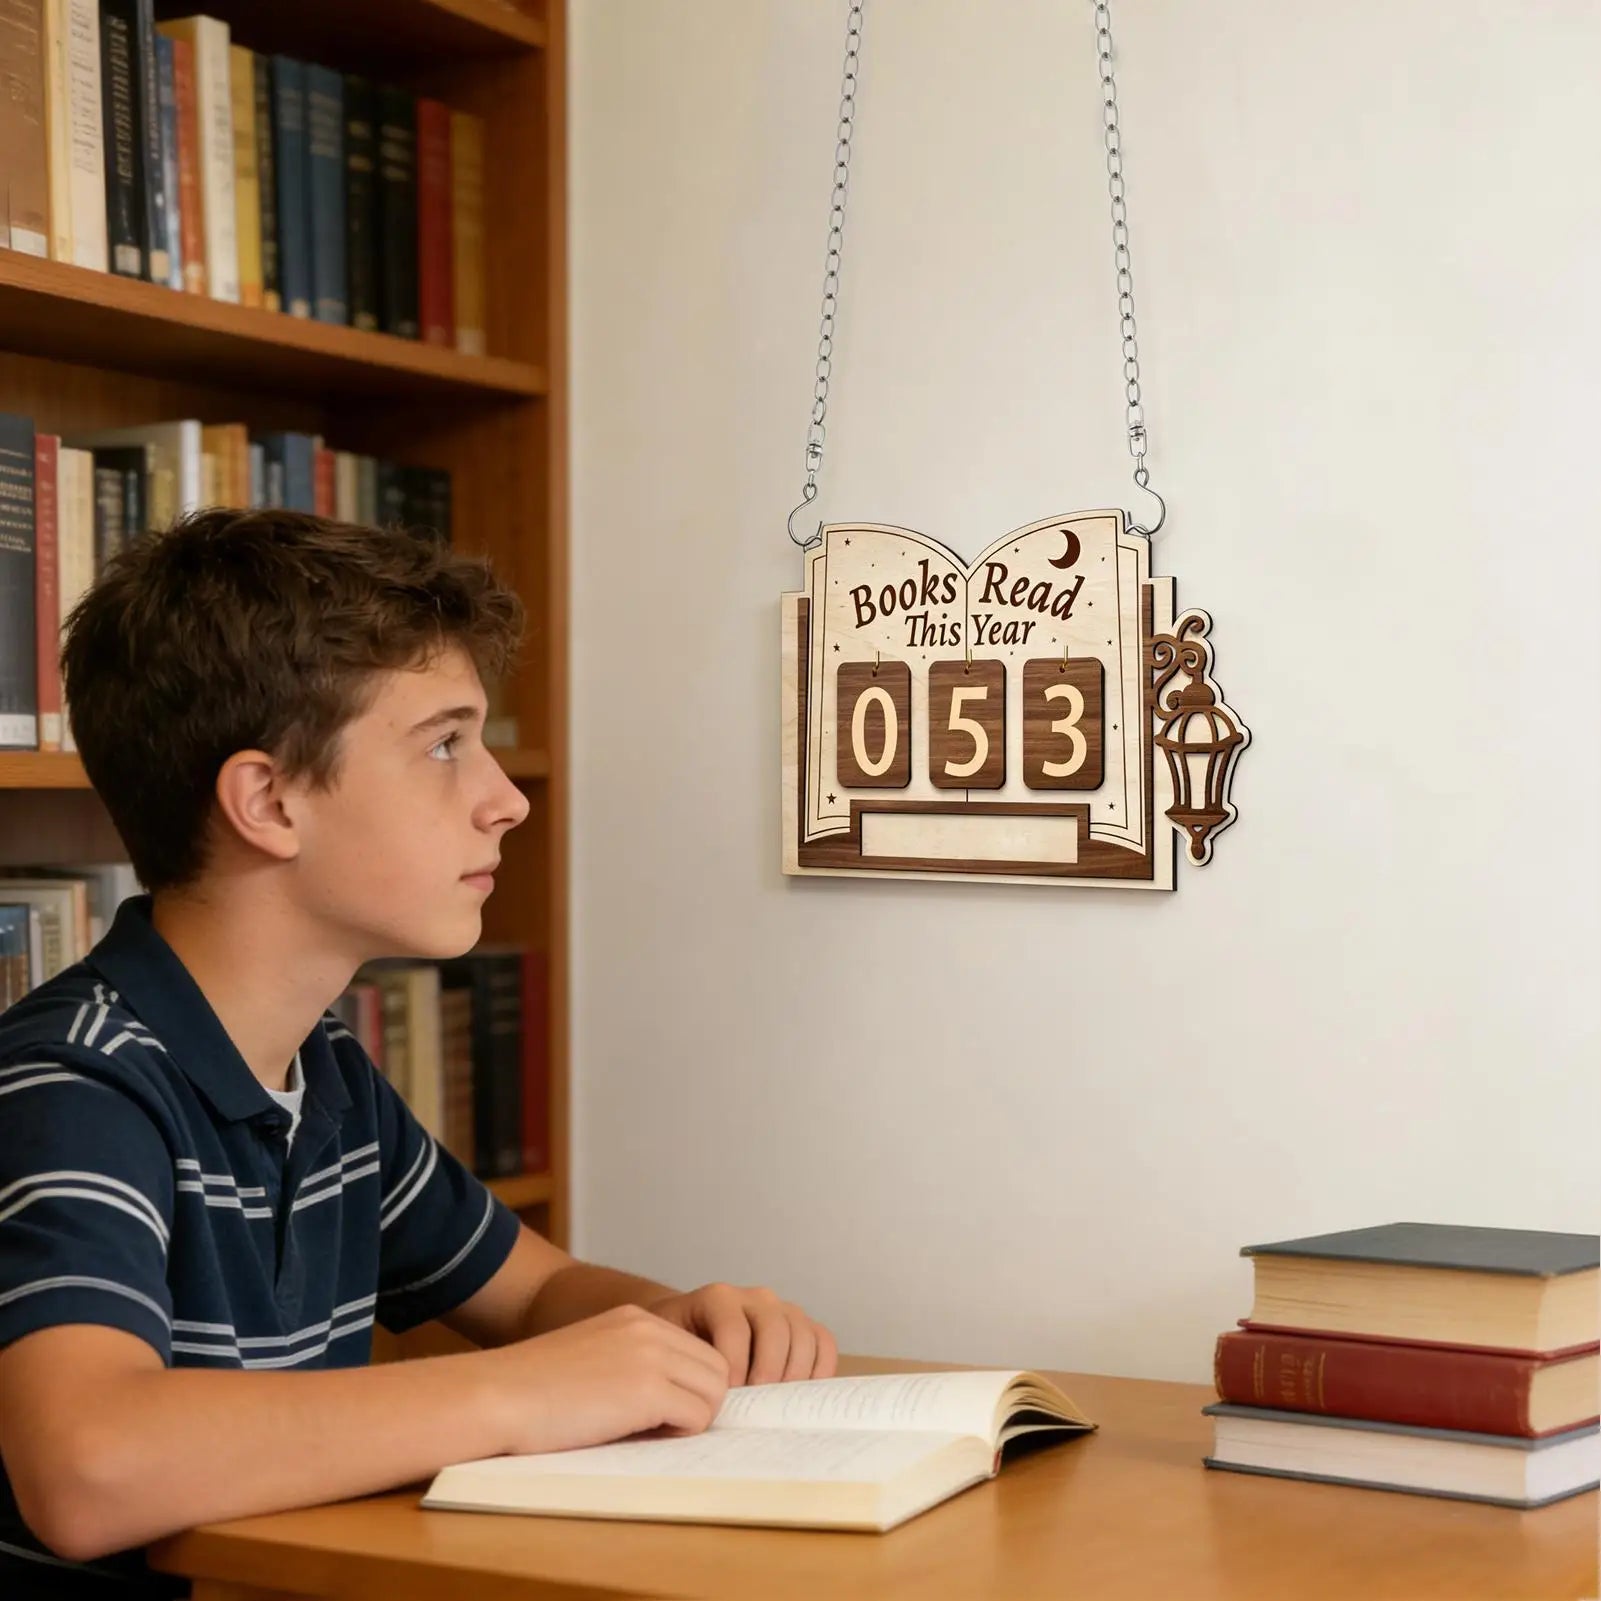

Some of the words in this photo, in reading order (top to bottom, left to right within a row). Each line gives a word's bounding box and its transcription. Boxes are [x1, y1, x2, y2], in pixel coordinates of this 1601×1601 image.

[849, 558, 958, 629] Books
[978, 562, 1086, 621] Read
[904, 610, 962, 647] This
[970, 613, 1037, 646] Year
